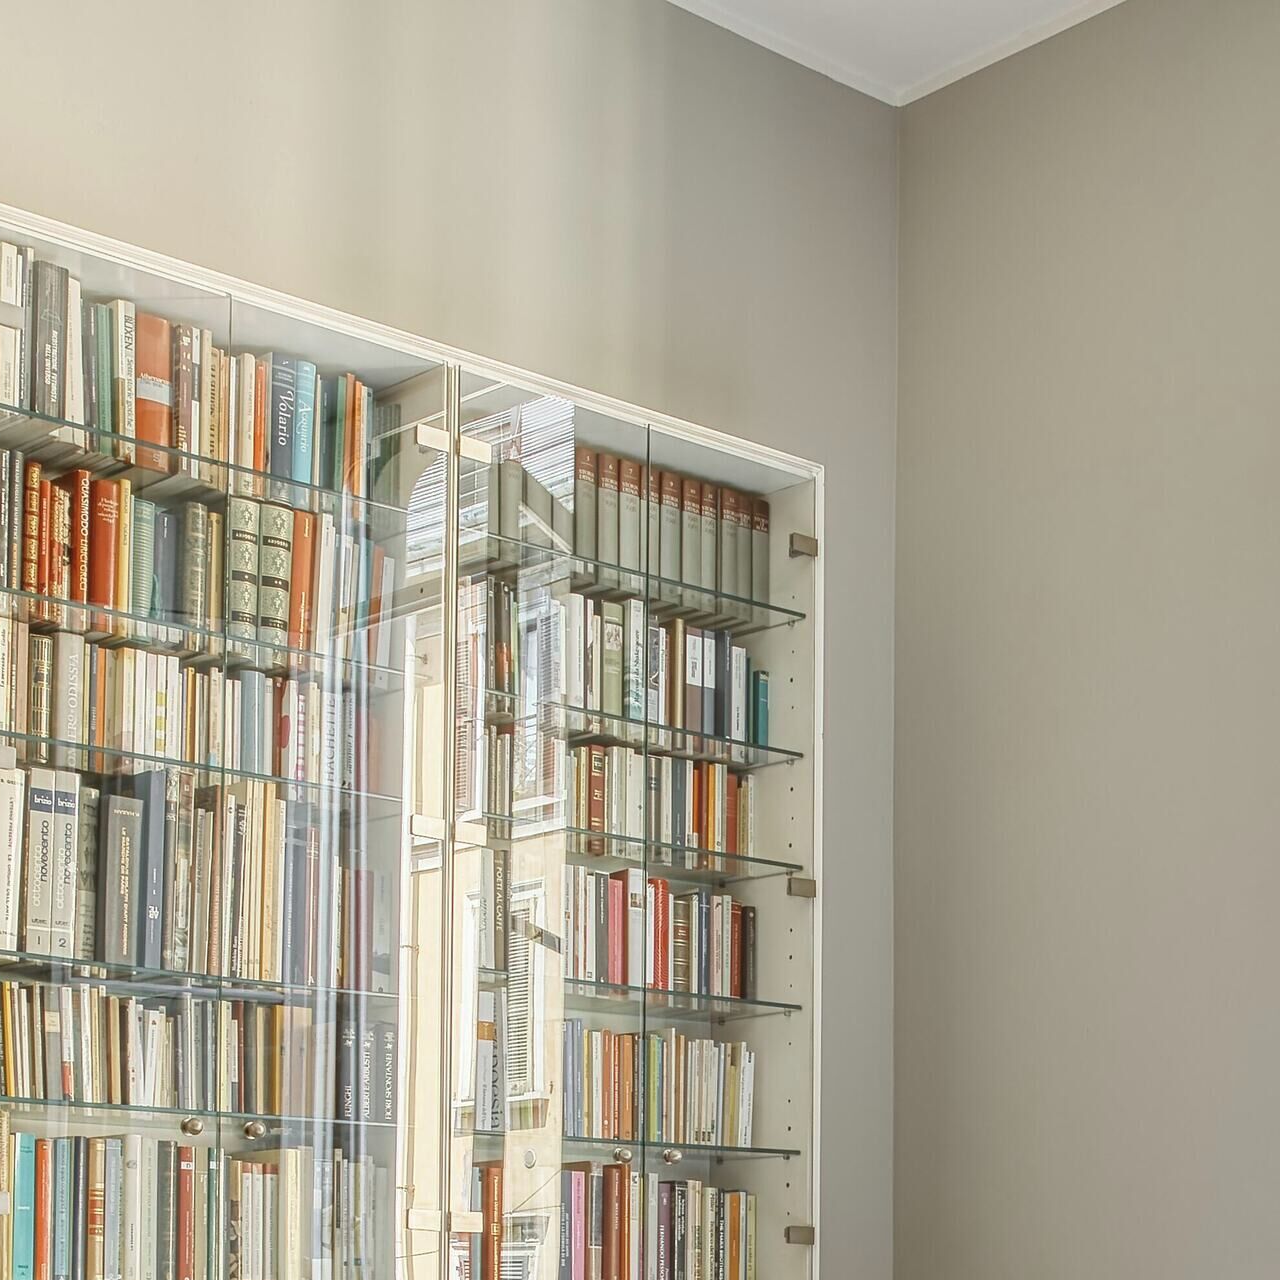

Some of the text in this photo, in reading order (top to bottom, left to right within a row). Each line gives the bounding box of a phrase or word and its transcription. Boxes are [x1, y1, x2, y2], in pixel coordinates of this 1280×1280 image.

[124, 315, 133, 350] BLIXEN
[278, 391, 294, 446] Volario
[296, 400, 312, 453] Acquario
[80, 479, 89, 591] QUASIMODO LIRICI GRECI
